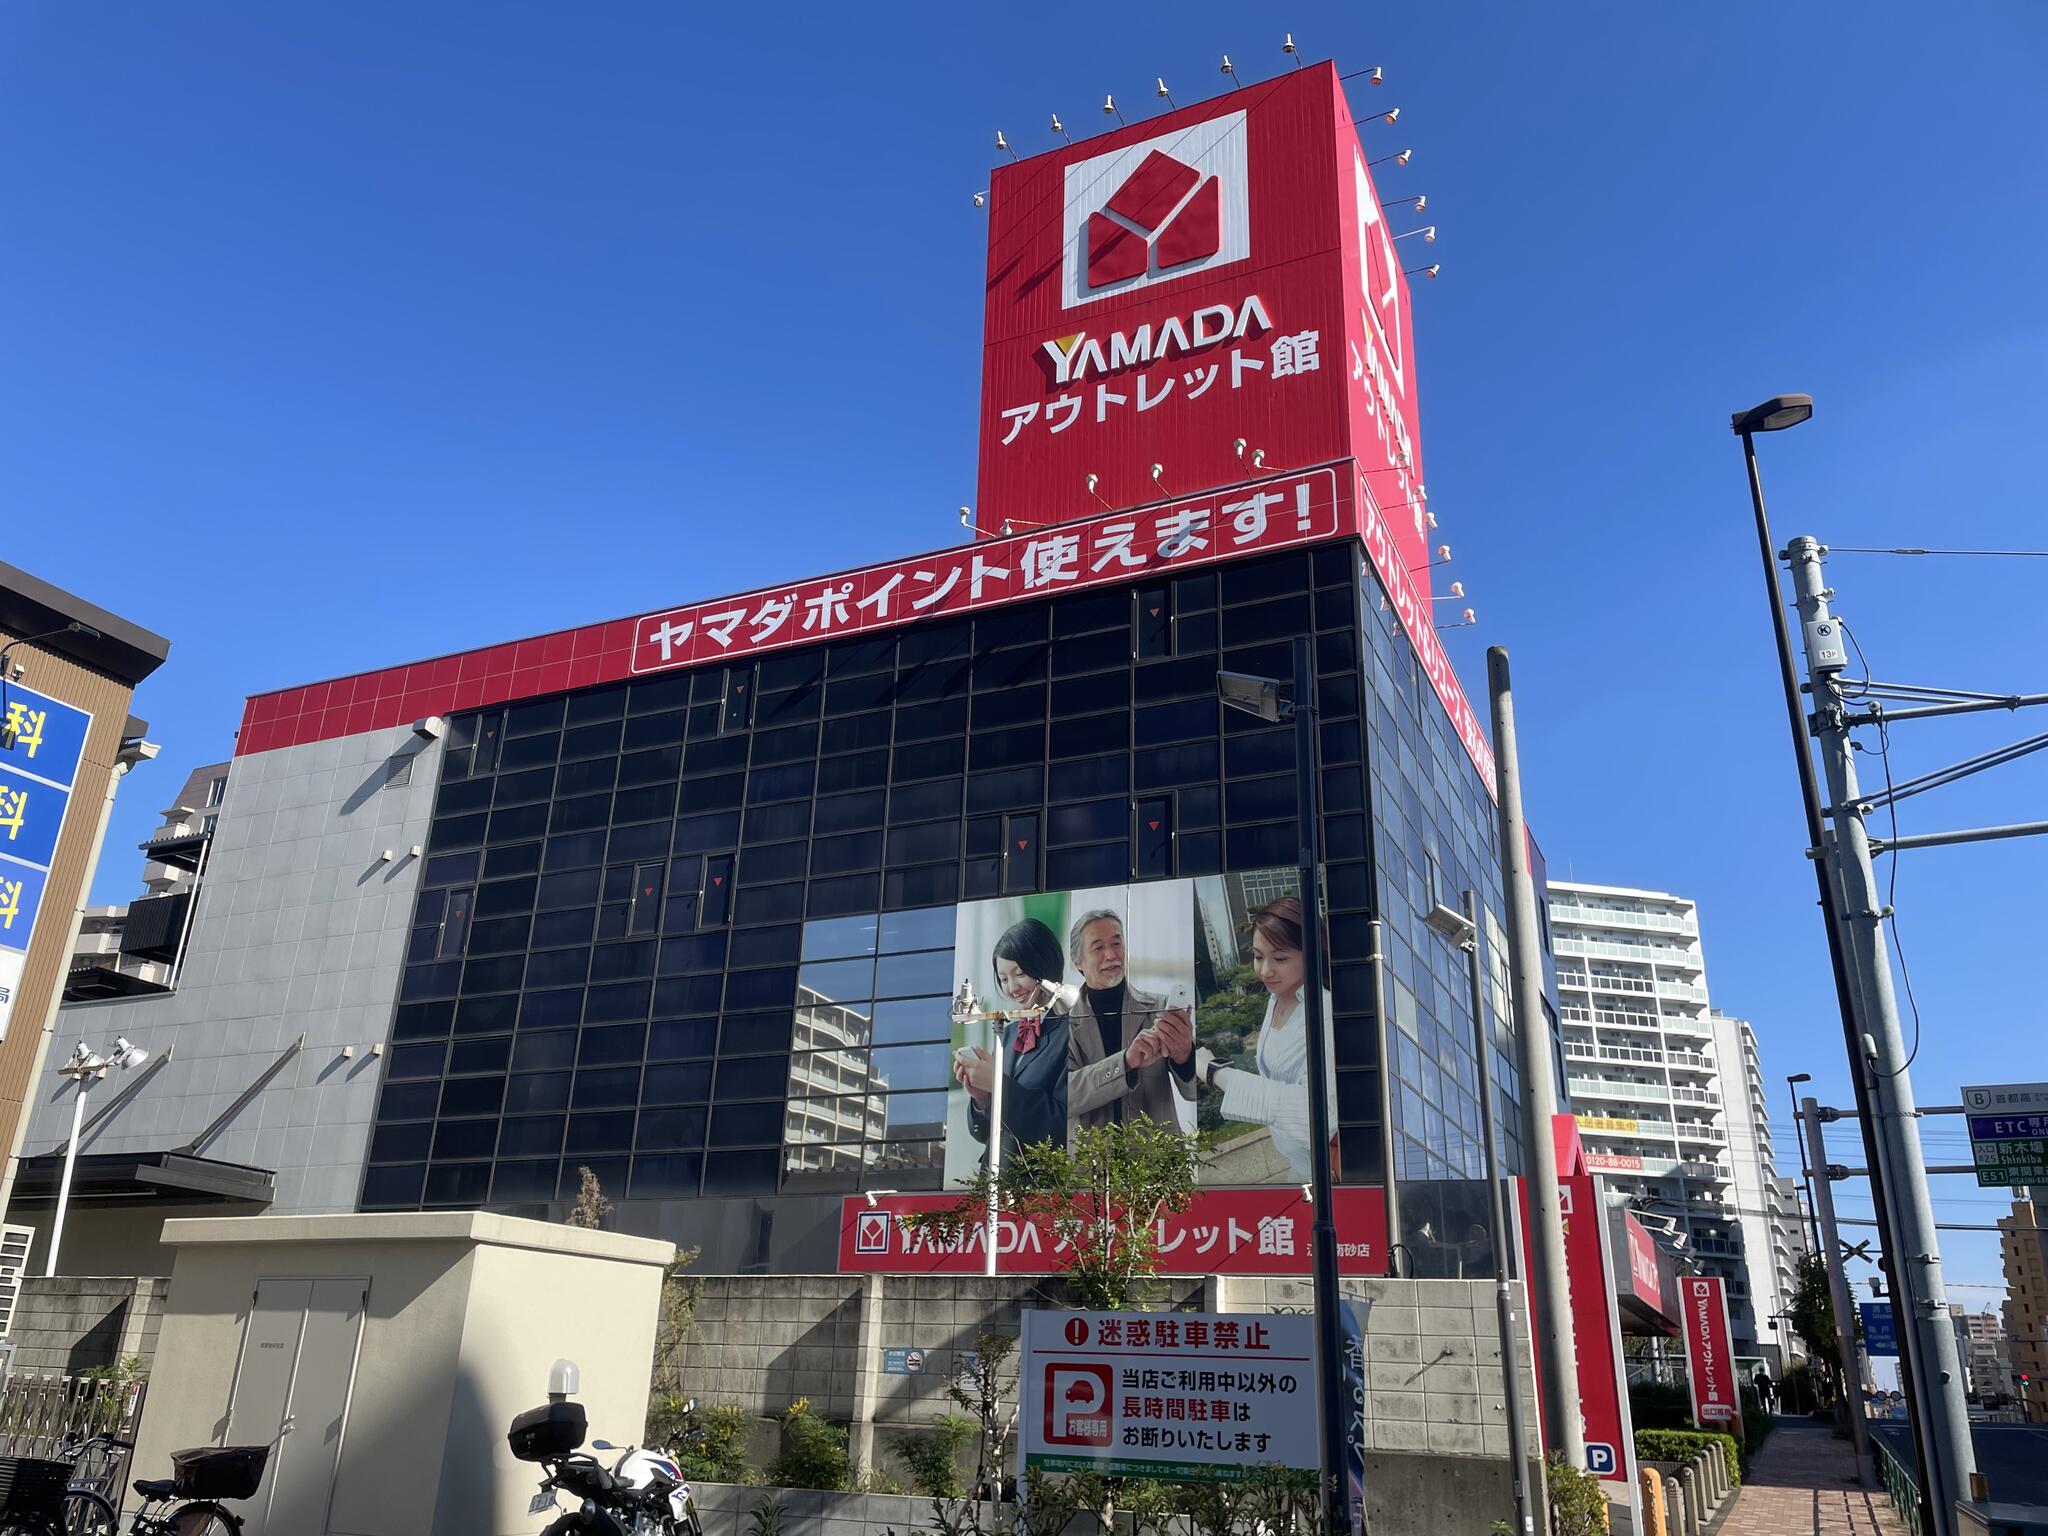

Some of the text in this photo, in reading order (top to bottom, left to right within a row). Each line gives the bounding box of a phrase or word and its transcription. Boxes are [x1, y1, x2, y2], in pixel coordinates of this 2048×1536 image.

[1042, 295, 1272, 385] YAMADA
[1001, 329, 1320, 446] アウトレット館
[649, 482, 1312, 662] ヤマダポイント使えます!
[2, 701, 46, 758] 科
[1974, 1093, 1985, 1105] B
[1994, 1120, 2027, 1133] ETC
[1999, 1141, 2044, 1154] 新木場
[1585, 1156, 1641, 1169] 0120-88-0015
[2001, 1154, 2042, 1165] Shinkiba
[1982, 1170, 2005, 1182] E51
[2008, 1165, 2048, 1177] 東関東
[1306, 1242, 1371, 1257] 南砂店
[1097, 1318, 1270, 1350] 迷惑駐車禁止
[1122, 1368, 1297, 1394] 当店ご利用中以外の
[1122, 1396, 1251, 1422] 長時間駐車は
[1067, 1419, 1108, 1438] お客様専用
[1122, 1426, 1271, 1453] お断りいたします
